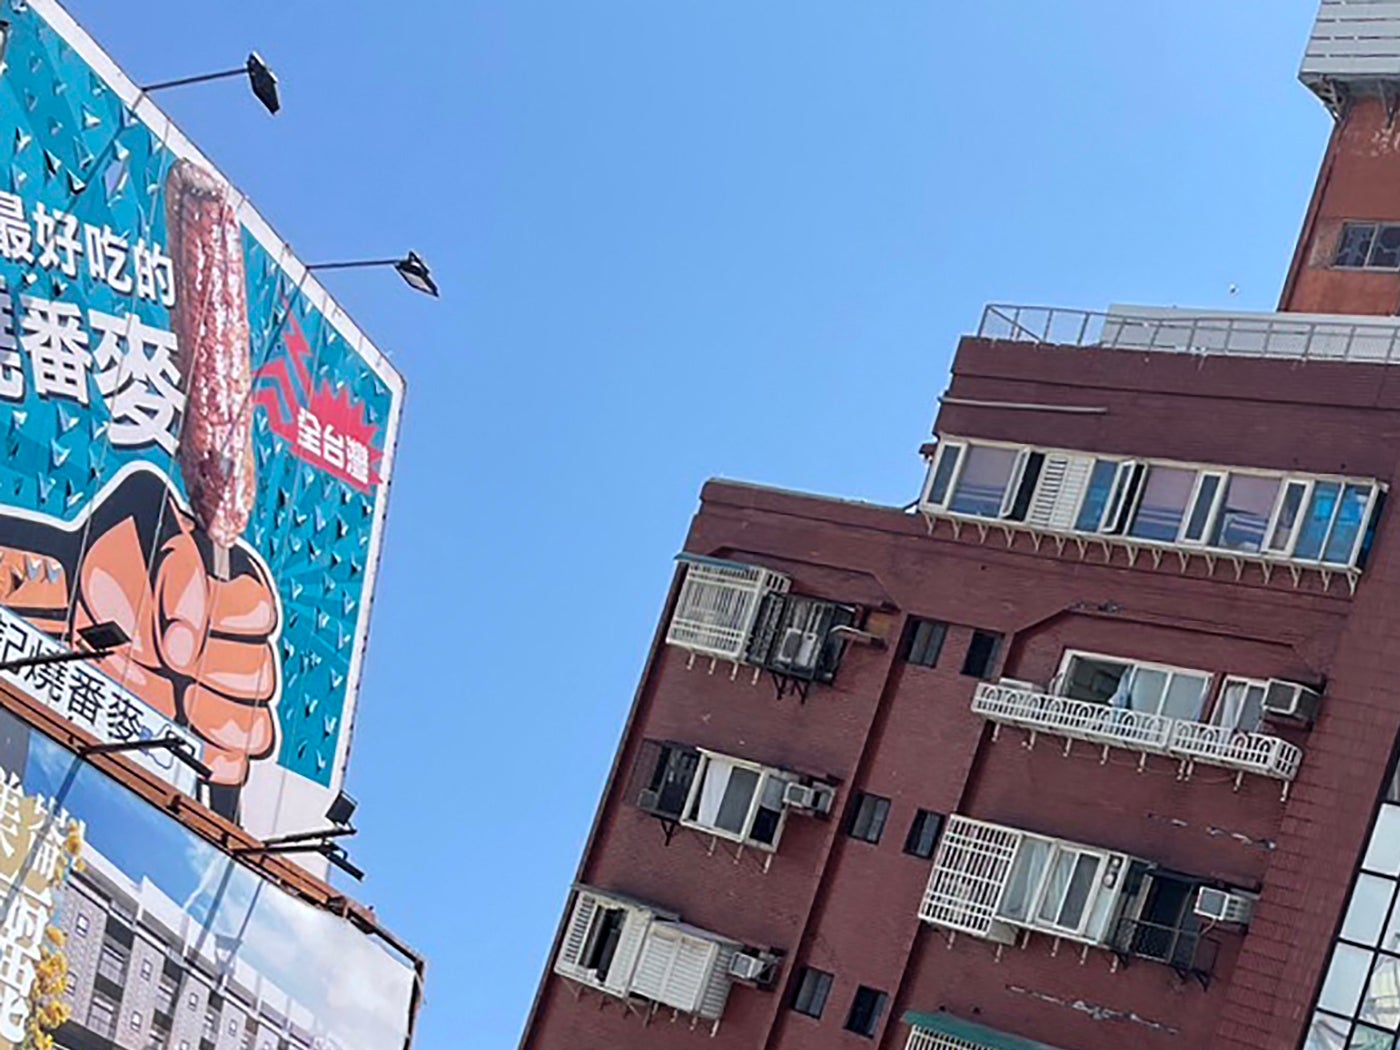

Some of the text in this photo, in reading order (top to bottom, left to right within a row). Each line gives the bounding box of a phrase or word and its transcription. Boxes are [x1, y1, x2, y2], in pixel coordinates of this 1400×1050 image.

[0, 191, 176, 306] 最好吃的
[297, 407, 369, 484] 全台灣
